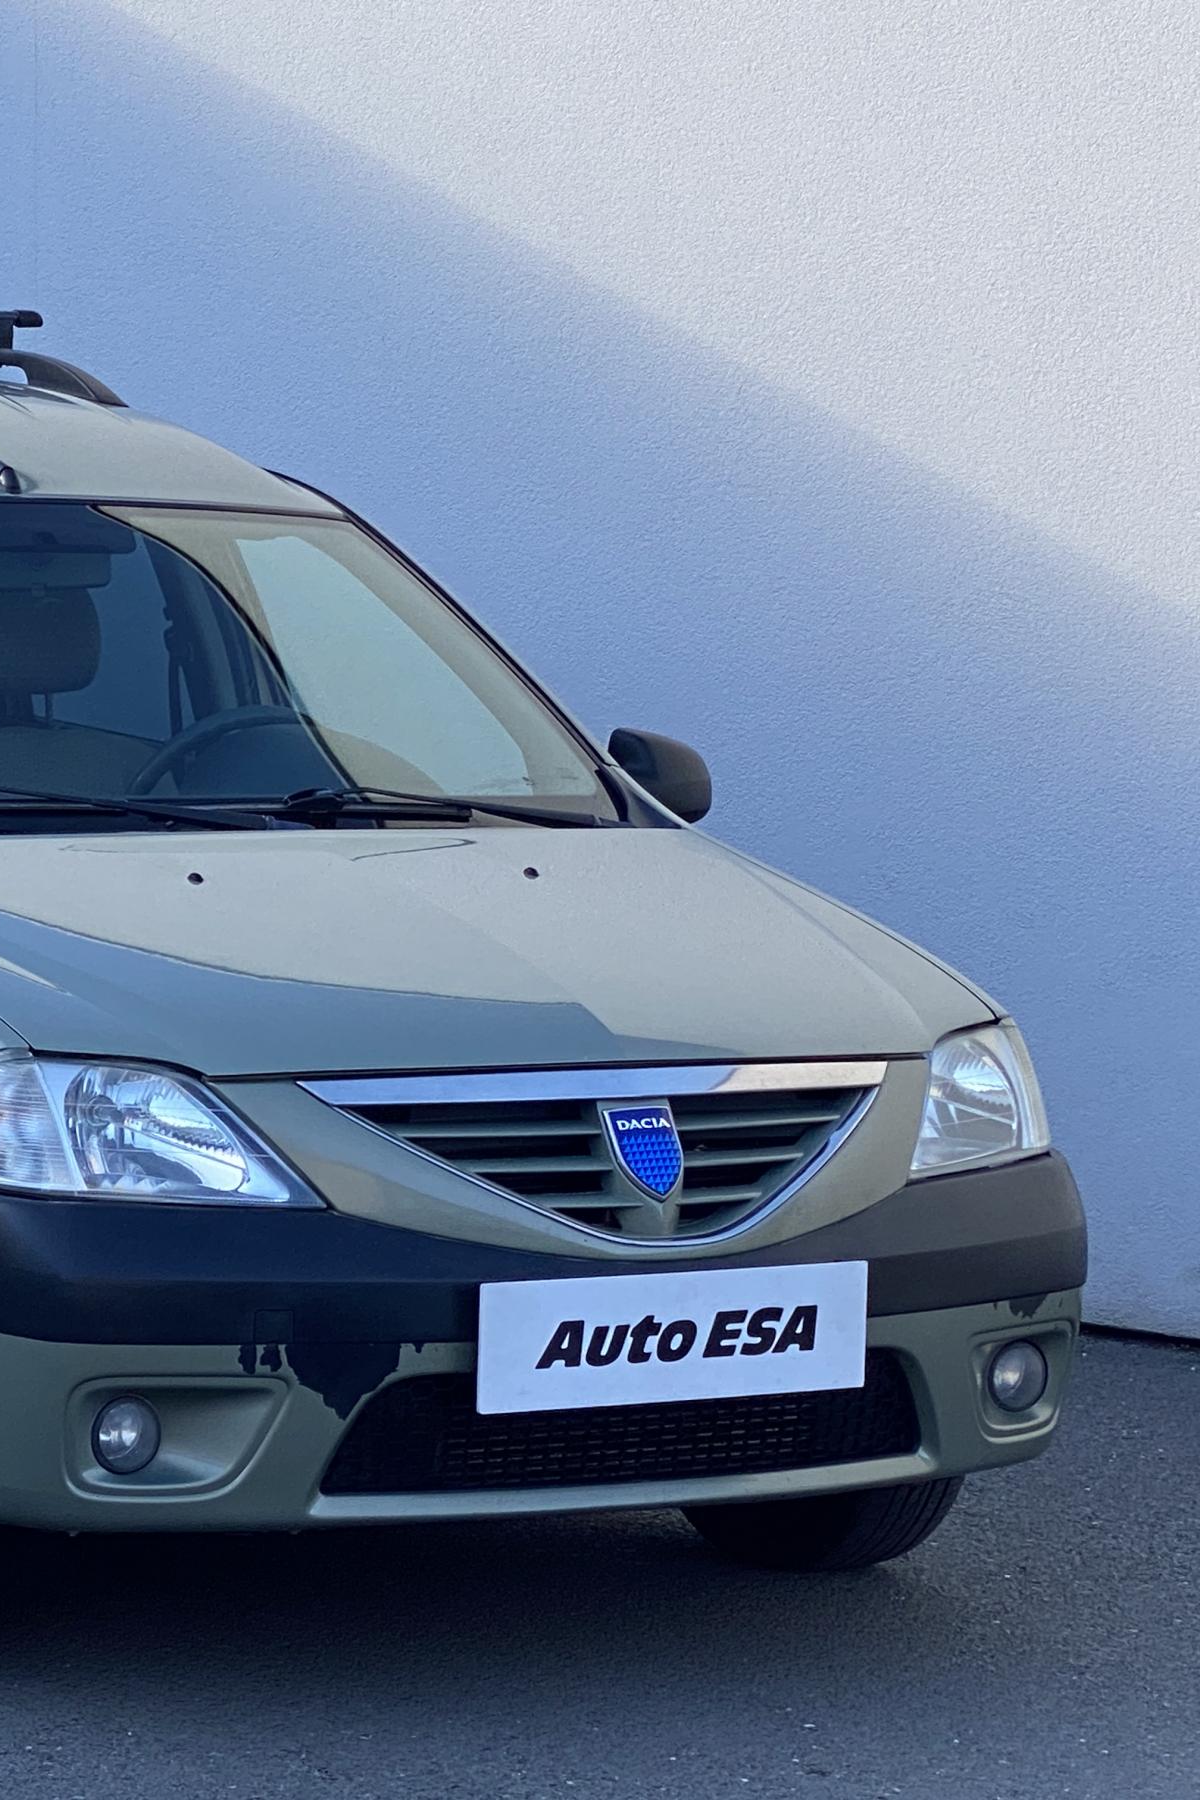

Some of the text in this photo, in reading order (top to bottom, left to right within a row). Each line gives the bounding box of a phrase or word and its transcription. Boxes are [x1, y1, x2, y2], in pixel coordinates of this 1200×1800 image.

[616, 1117, 671, 1131] DACIA
[535, 1305, 818, 1370] Auto ESA
